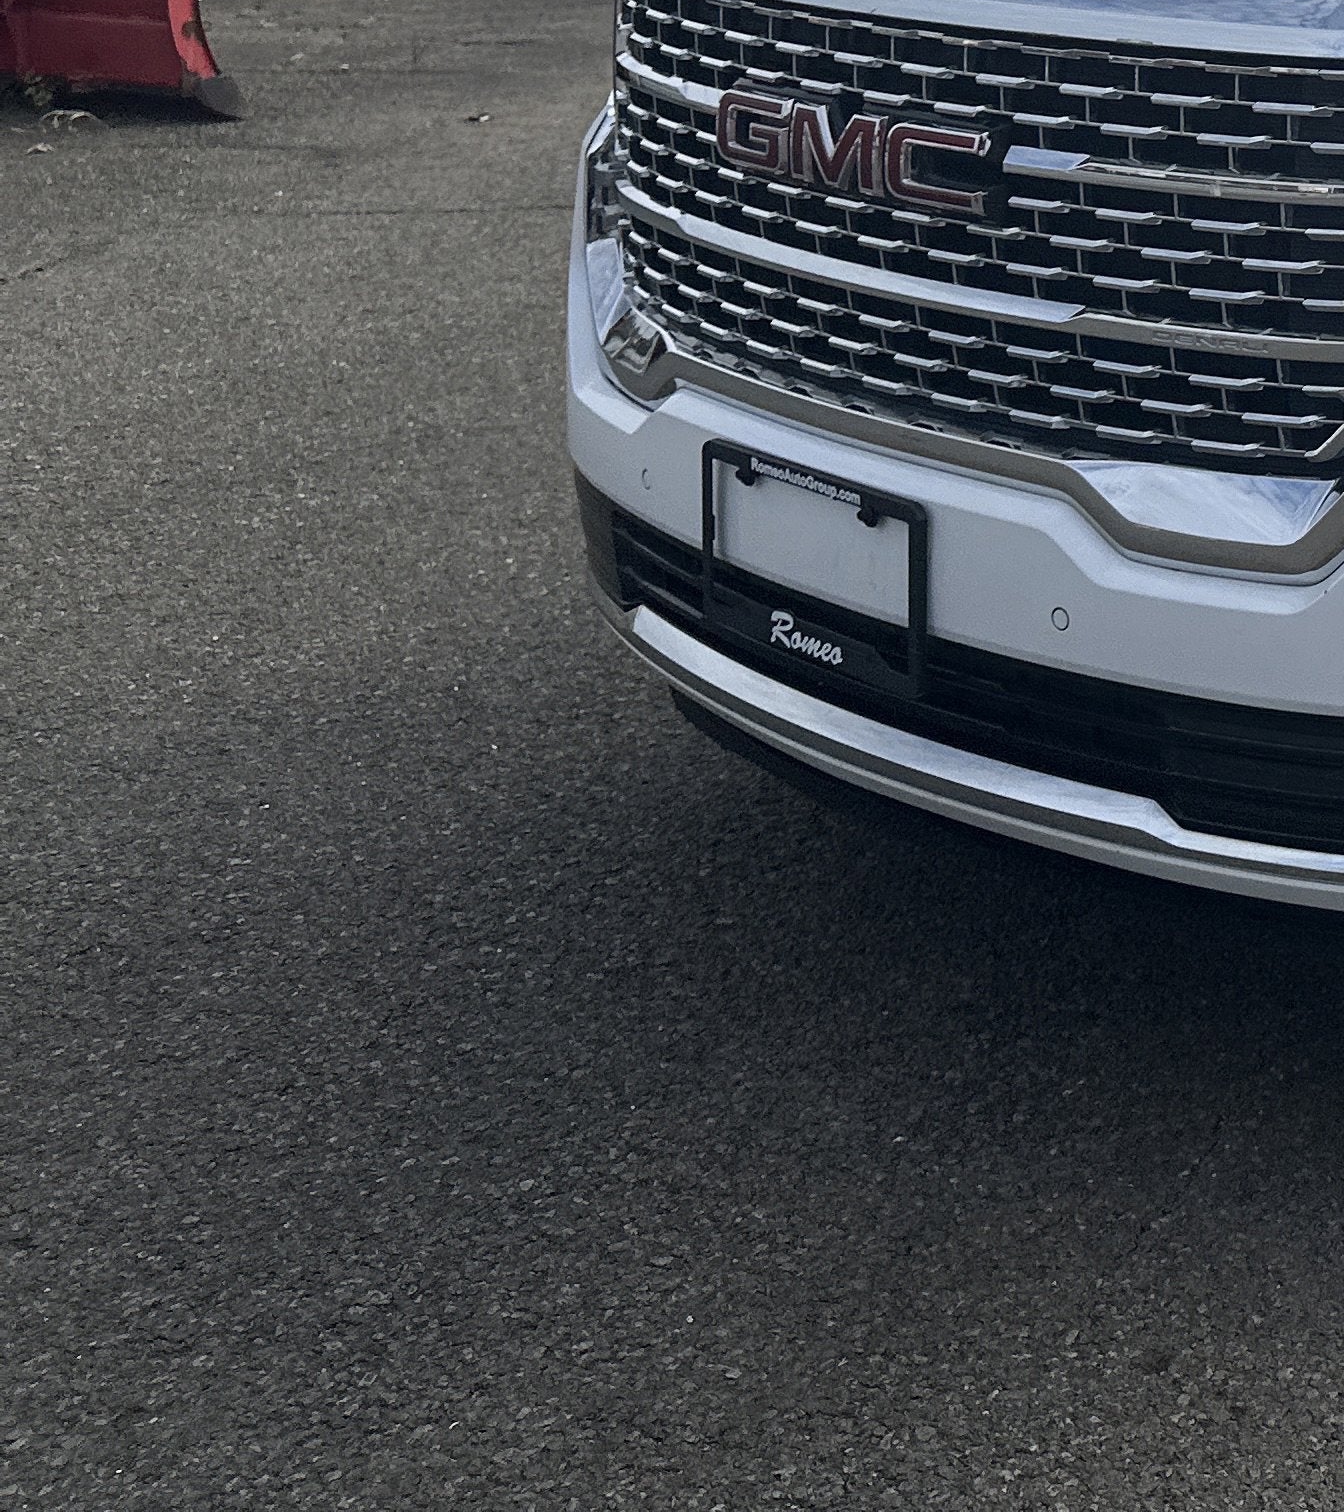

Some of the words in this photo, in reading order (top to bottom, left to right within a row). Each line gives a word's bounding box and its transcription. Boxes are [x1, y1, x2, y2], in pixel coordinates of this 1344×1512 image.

[716, 88, 992, 217] GMC
[750, 457, 862, 506] RomeoAutoGroup.com
[770, 610, 843, 666] Romeo
